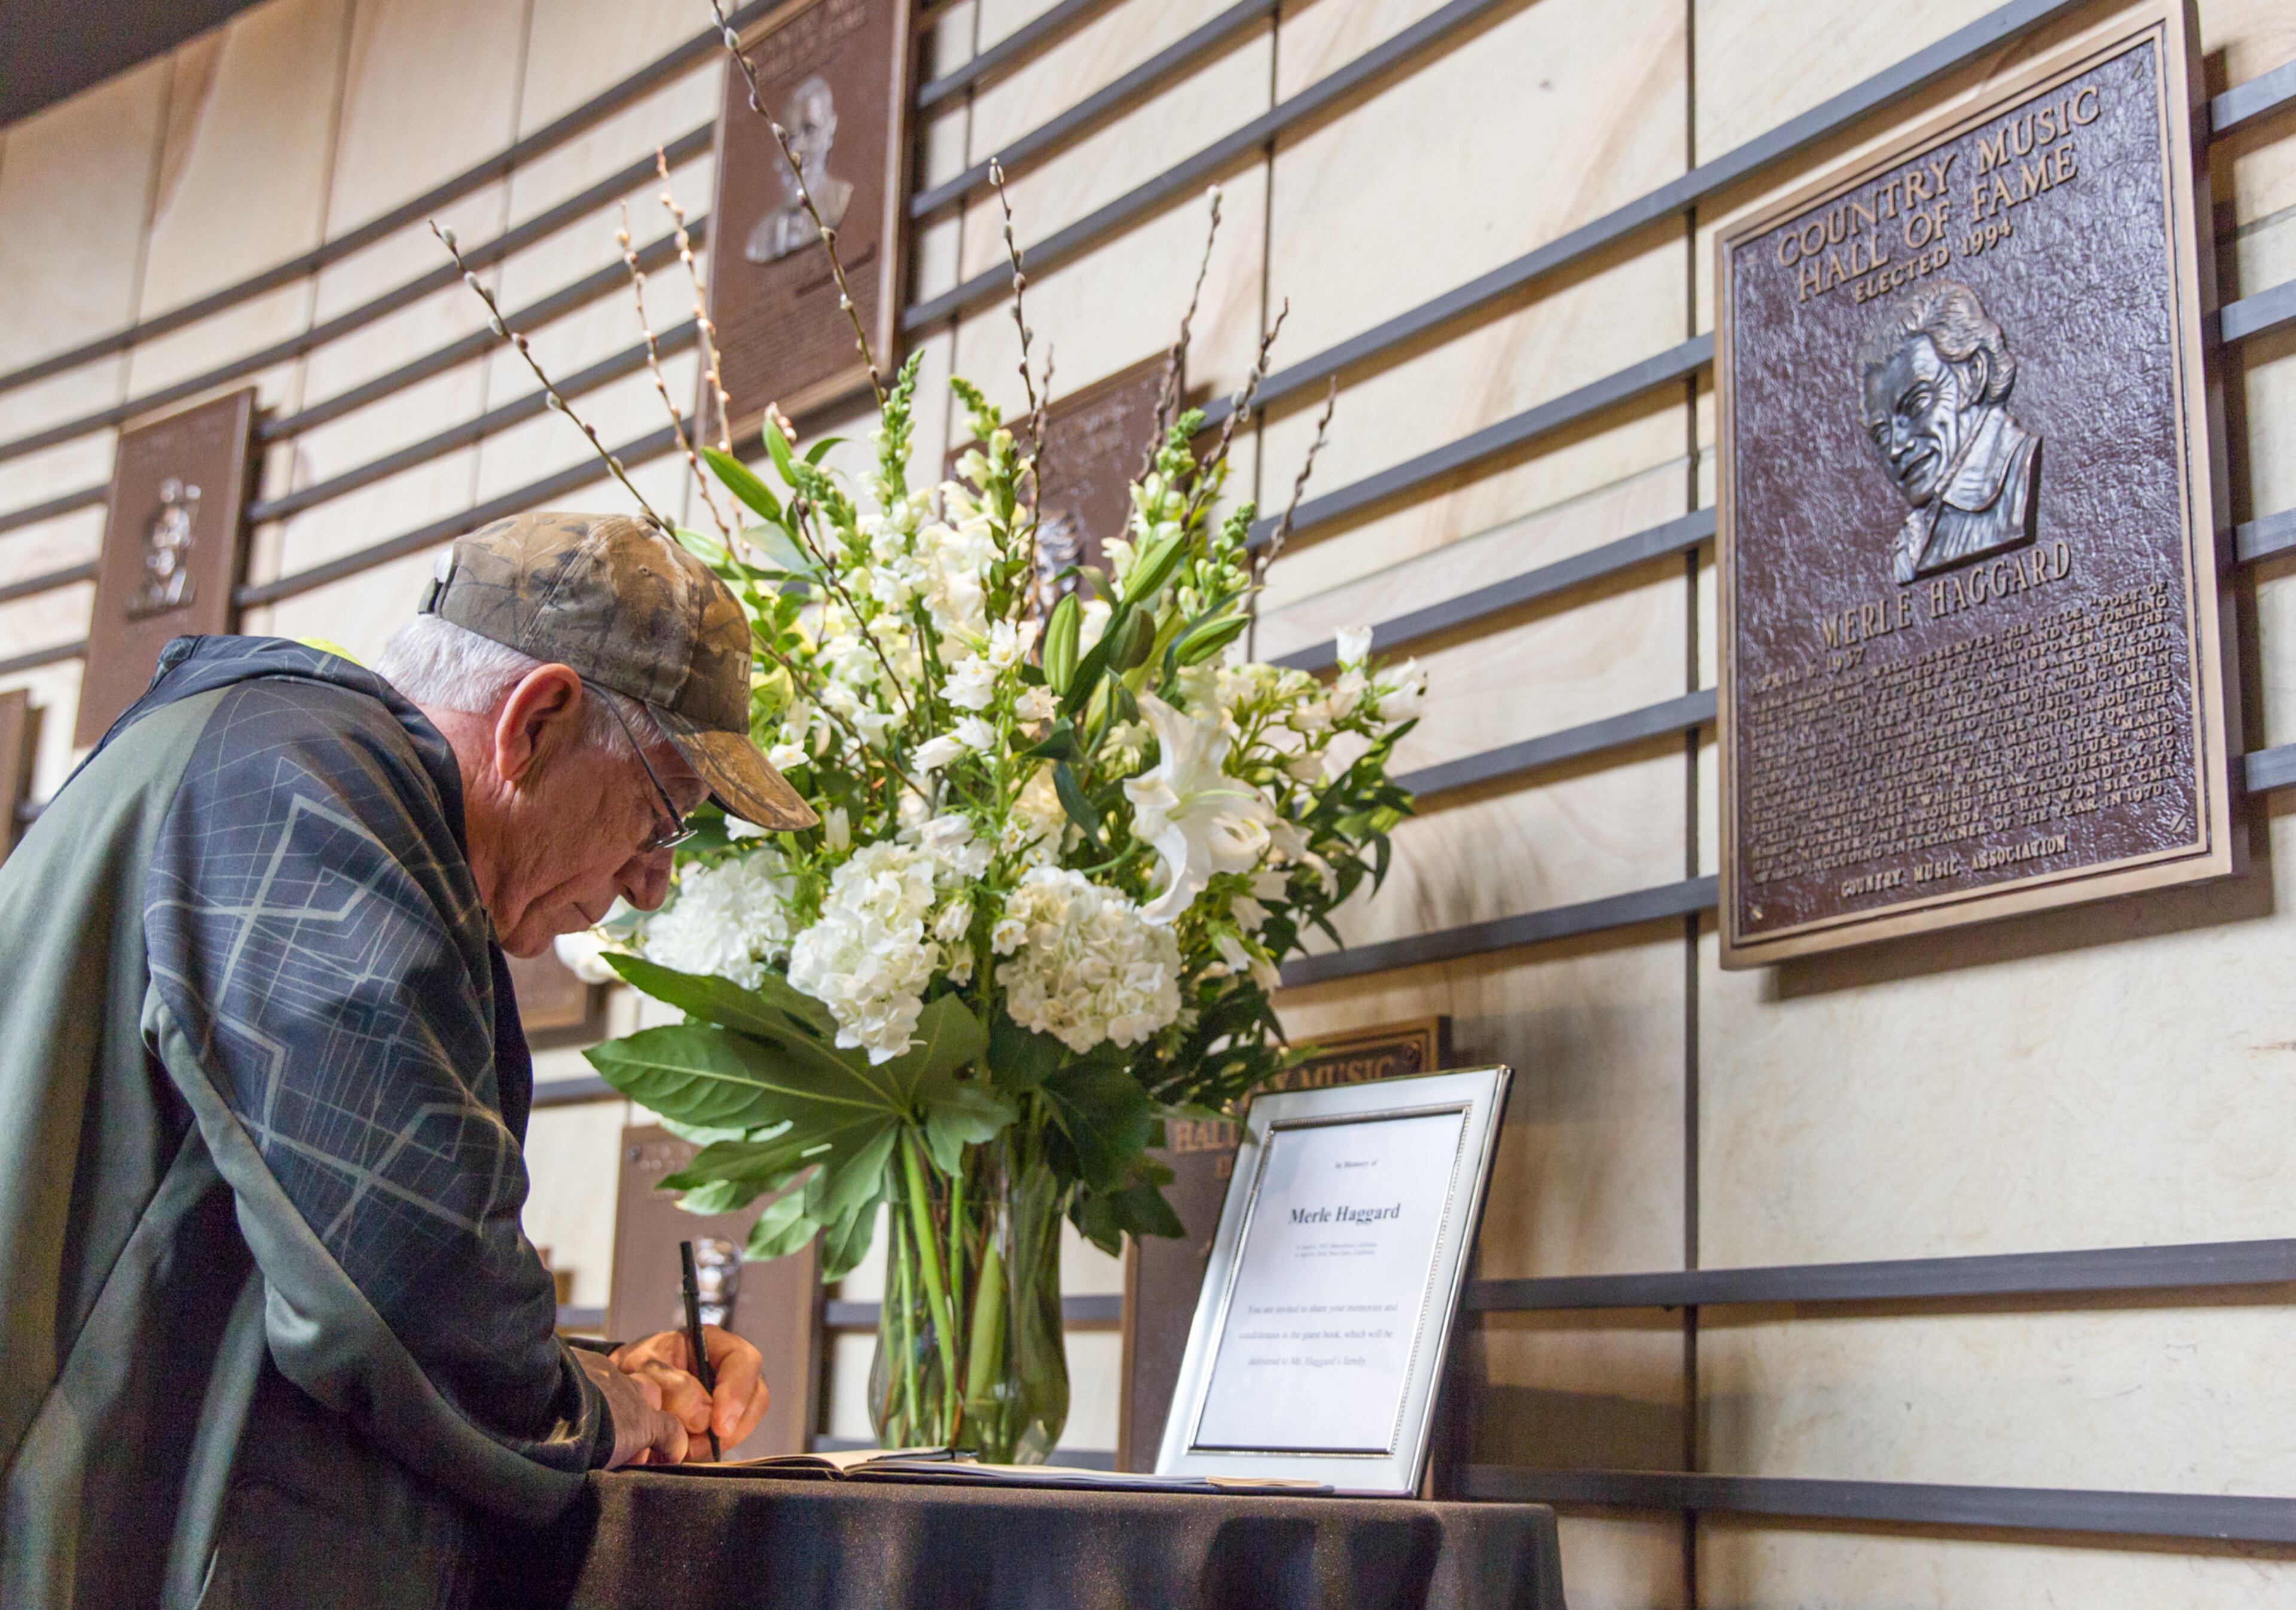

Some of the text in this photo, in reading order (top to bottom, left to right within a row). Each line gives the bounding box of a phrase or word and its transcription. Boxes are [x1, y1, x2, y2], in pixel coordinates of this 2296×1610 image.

[1778, 85, 2101, 267] COUNTRY MUSIC
[1797, 142, 2079, 303] HALL OF FAME
[1855, 218, 2014, 304] ELECTED 1994
[1821, 541, 2073, 651] MERLE HAGGARD
[2029, 624, 2061, 646] AND
[2066, 593, 2169, 636] PERFORMING
[1872, 656, 1911, 678] WELL
[1916, 631, 1994, 665] DESERVES
[2002, 620, 2030, 640] THE
[2039, 605, 2083, 630] TITLE
[2146, 579, 2167, 597] OF
[1905, 672, 1943, 695] DEEP
[1983, 628, 2095, 673] PLAINSPOKEN
[2102, 607, 2169, 638] TRUTHS.
[2016, 661, 2032, 677] IN
[2038, 622, 2170, 671] BAKERSFIELD,
[1985, 706, 2016, 726] THE
[2078, 683, 2099, 701] OF
[2105, 663, 2172, 694] JIMMIE
[1999, 688, 2031, 709] AND
[2034, 667, 2108, 699] HANGING
[2114, 656, 2145, 678] OUT
[2152, 649, 2172, 668] IN
[2053, 659, 2086, 681] AND
[2007, 713, 2091, 747] MEANING
[2095, 702, 2129, 723] FOR
[2031, 702, 2079, 727] SONGS
[2084, 686, 2137, 713] ABOUT
[2141, 677, 2174, 698] THE
[1921, 783, 1972, 808] WHICH
[1978, 769, 2029, 794] SPEAK
[2035, 741, 2147, 780] ELOQUENTLY
[2154, 734, 2175, 753] TO
[2006, 734, 2059, 760] SONGS
[2067, 723, 2104, 745] LIKE
[2026, 747, 2061, 768] MAN
[2136, 719, 2174, 741] AND
[1979, 788, 2008, 807] THE
[2015, 772, 2074, 799] WORLD
[2078, 763, 2113, 784] AND
[2119, 748, 2176, 774] TYPIFY
[1993, 801, 2012, 818] HE
[2020, 792, 2051, 811] HAS
[2059, 781, 2097, 803] WON
[2102, 772, 2133, 792] SIX
[2137, 762, 2176, 785] CMA
[1993, 814, 2013, 832] OF
[2020, 806, 2050, 826] THE
[2054, 795, 2099, 818] YEAR
[2103, 790, 2122, 807] IN
[1841, 832, 2069, 897] COUNTRY MUSIC ASSOCIATION
[1288, 1202, 1402, 1226] Merle Haggard
